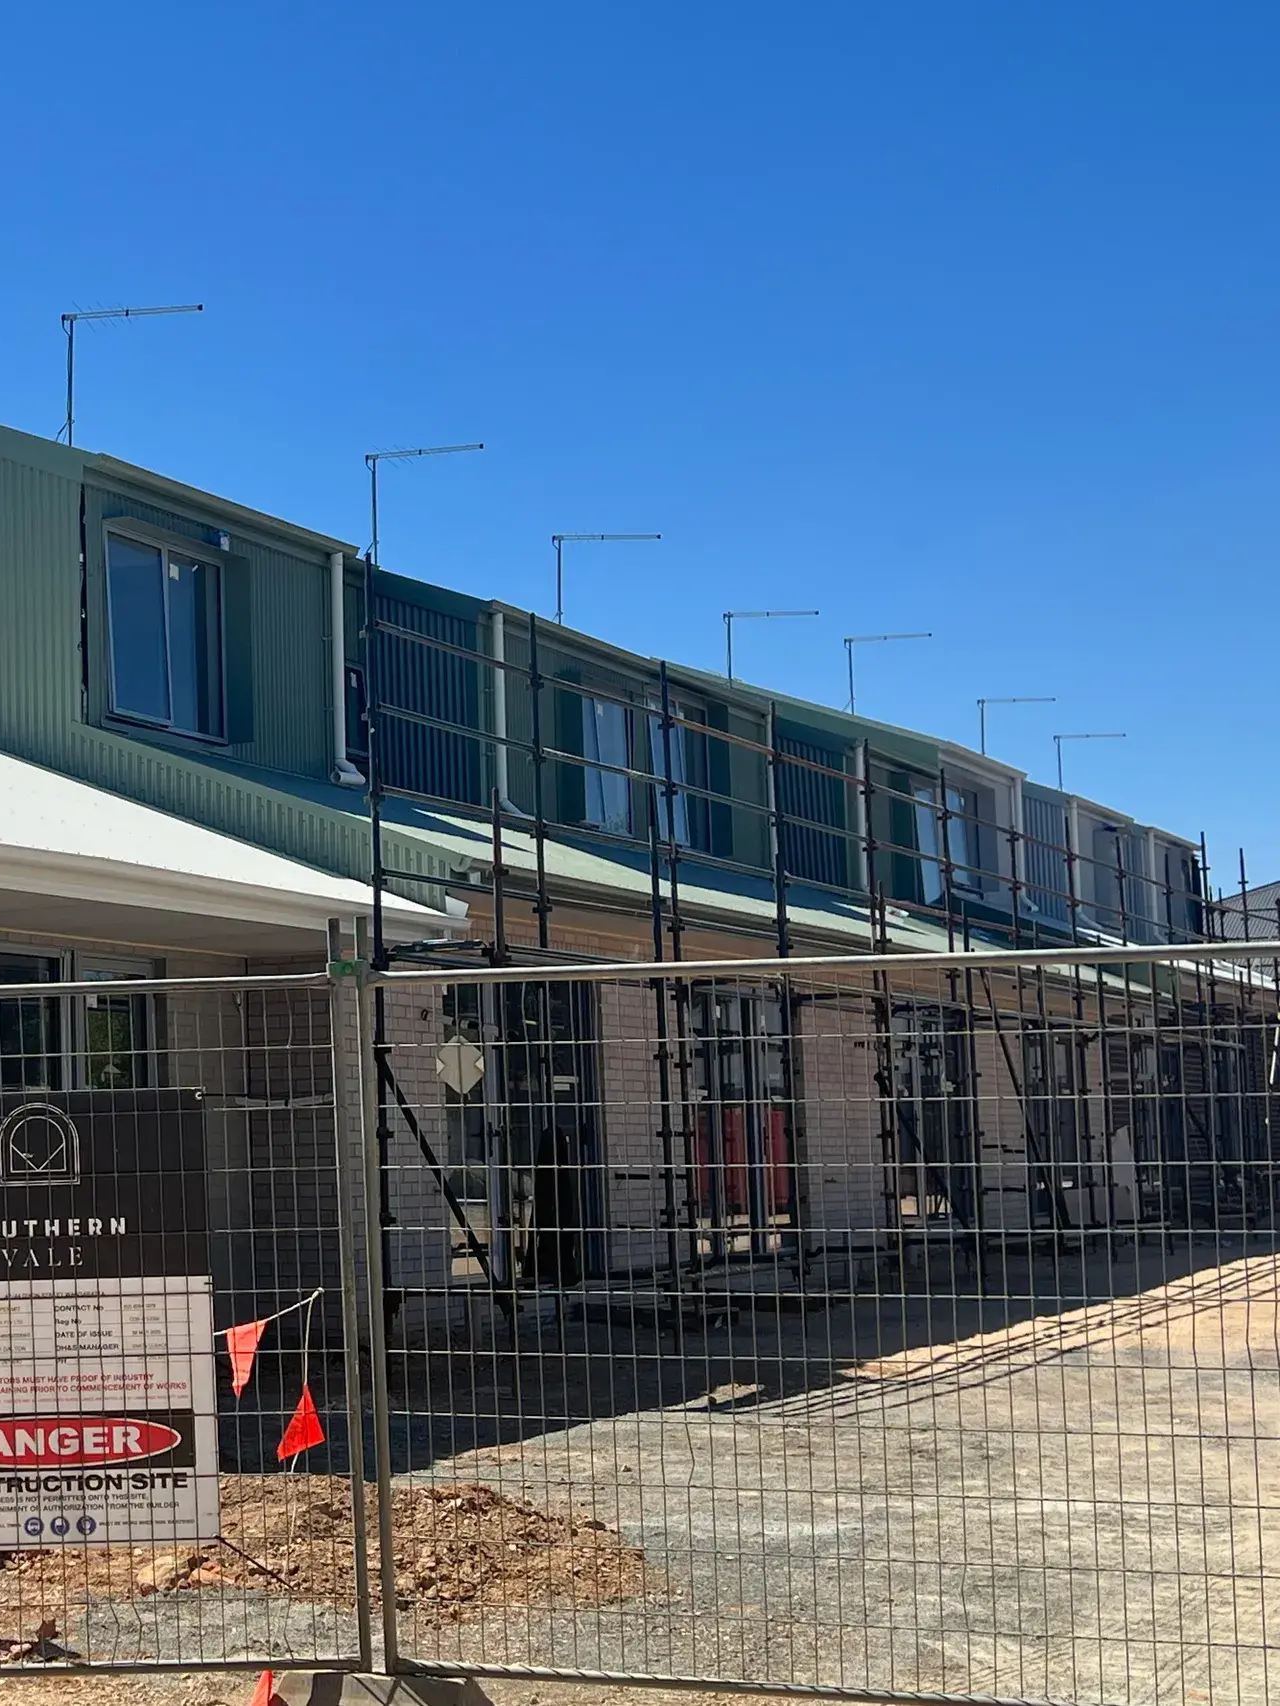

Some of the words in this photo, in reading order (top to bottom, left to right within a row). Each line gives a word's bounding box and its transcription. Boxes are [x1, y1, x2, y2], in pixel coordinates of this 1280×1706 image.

[0, 1246, 83, 1267] VALE
[22, 1376, 46, 1384] MUST
[48, 1375, 68, 1384] HAVE
[70, 1374, 98, 1382] PROOF
[100, 1374, 112, 1382] OF
[113, 1373, 154, 1381] INDUSTRY
[30, 1385, 56, 1394] PRIOR
[70, 1383, 141, 1392] COMMENCEMENT
[132, 1472, 188, 1491] SITE
[43, 1504, 104, 1512] AUTHORIZATION
